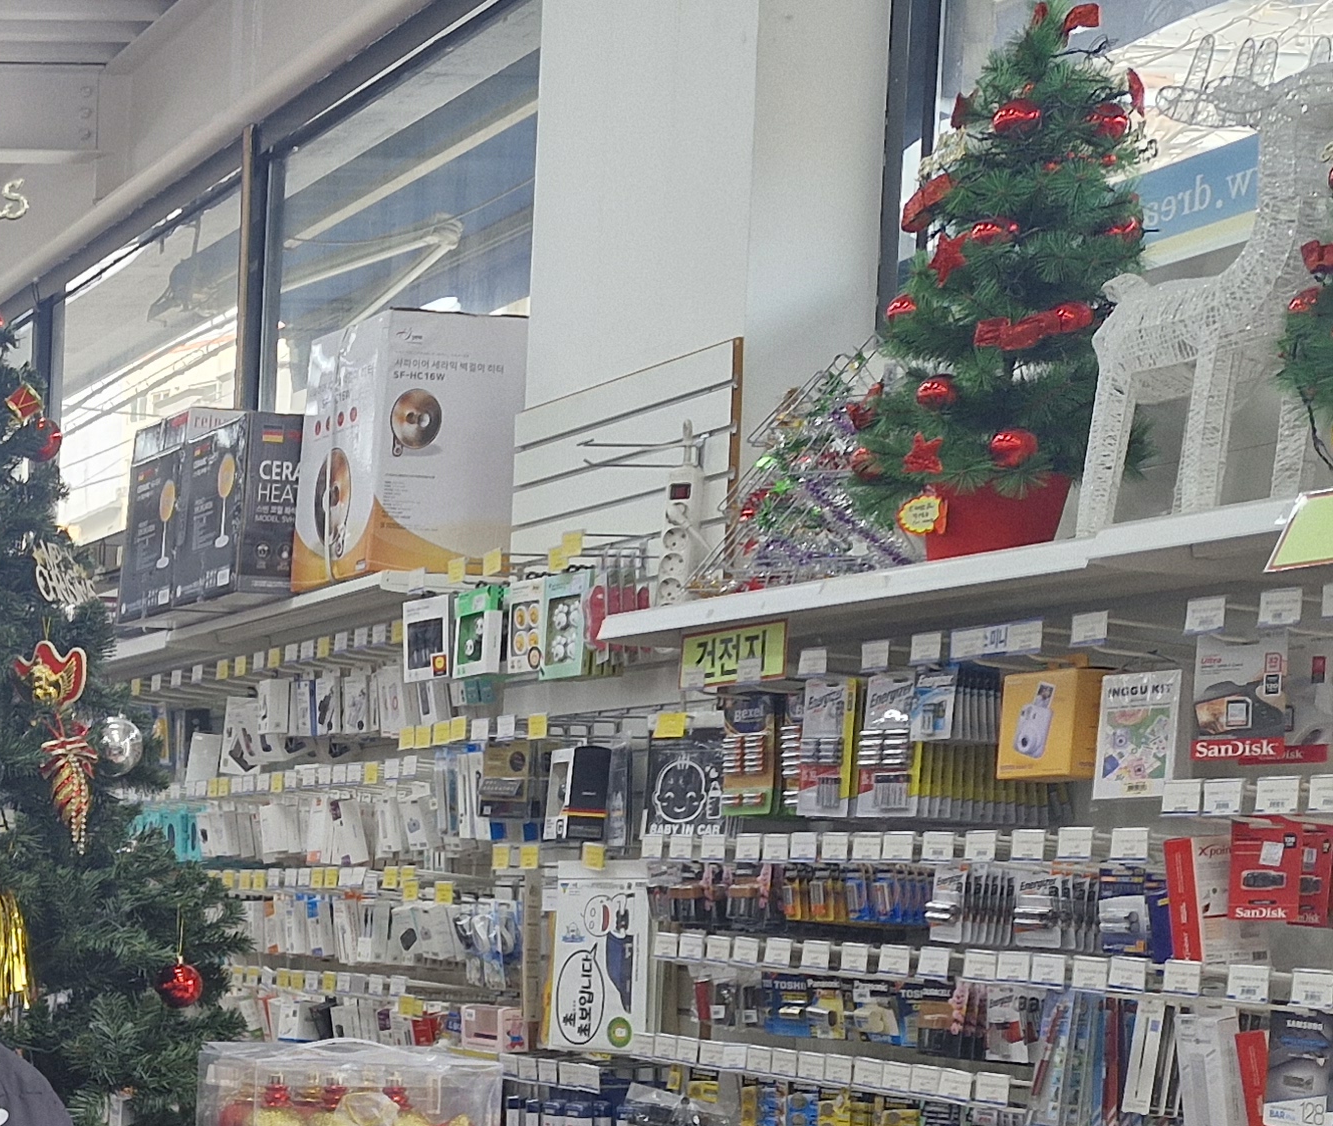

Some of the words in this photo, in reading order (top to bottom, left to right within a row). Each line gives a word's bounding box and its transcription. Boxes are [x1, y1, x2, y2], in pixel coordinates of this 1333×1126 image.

[395, 358, 431, 370] 사파이어
[431, 360, 460, 372] 세라믹
[461, 362, 486, 374] 벽걸이
[488, 363, 505, 375] 히터
[393, 370, 446, 382] SF-HC16W
[695, 629, 768, 679] 건전지
[870, 682, 914, 708] Energizer
[734, 706, 764, 722] Bexel
[1195, 740, 1276, 759] SanDisk
[649, 822, 680, 837] BABY
[681, 822, 696, 837] IN
[698, 822, 721, 837] CAR
[1020, 874, 1059, 890] Energizer
[1235, 905, 1287, 919] SanDisk
[807, 978, 841, 989] Panasonic
[853, 980, 889, 992] Panasonic
[577, 954, 595, 1038] 초보입니다
[1285, 1019, 1324, 1032] SAMSUNG
[1269, 1108, 1286, 1120] BAR
[1299, 1101, 1325, 1126] 128
